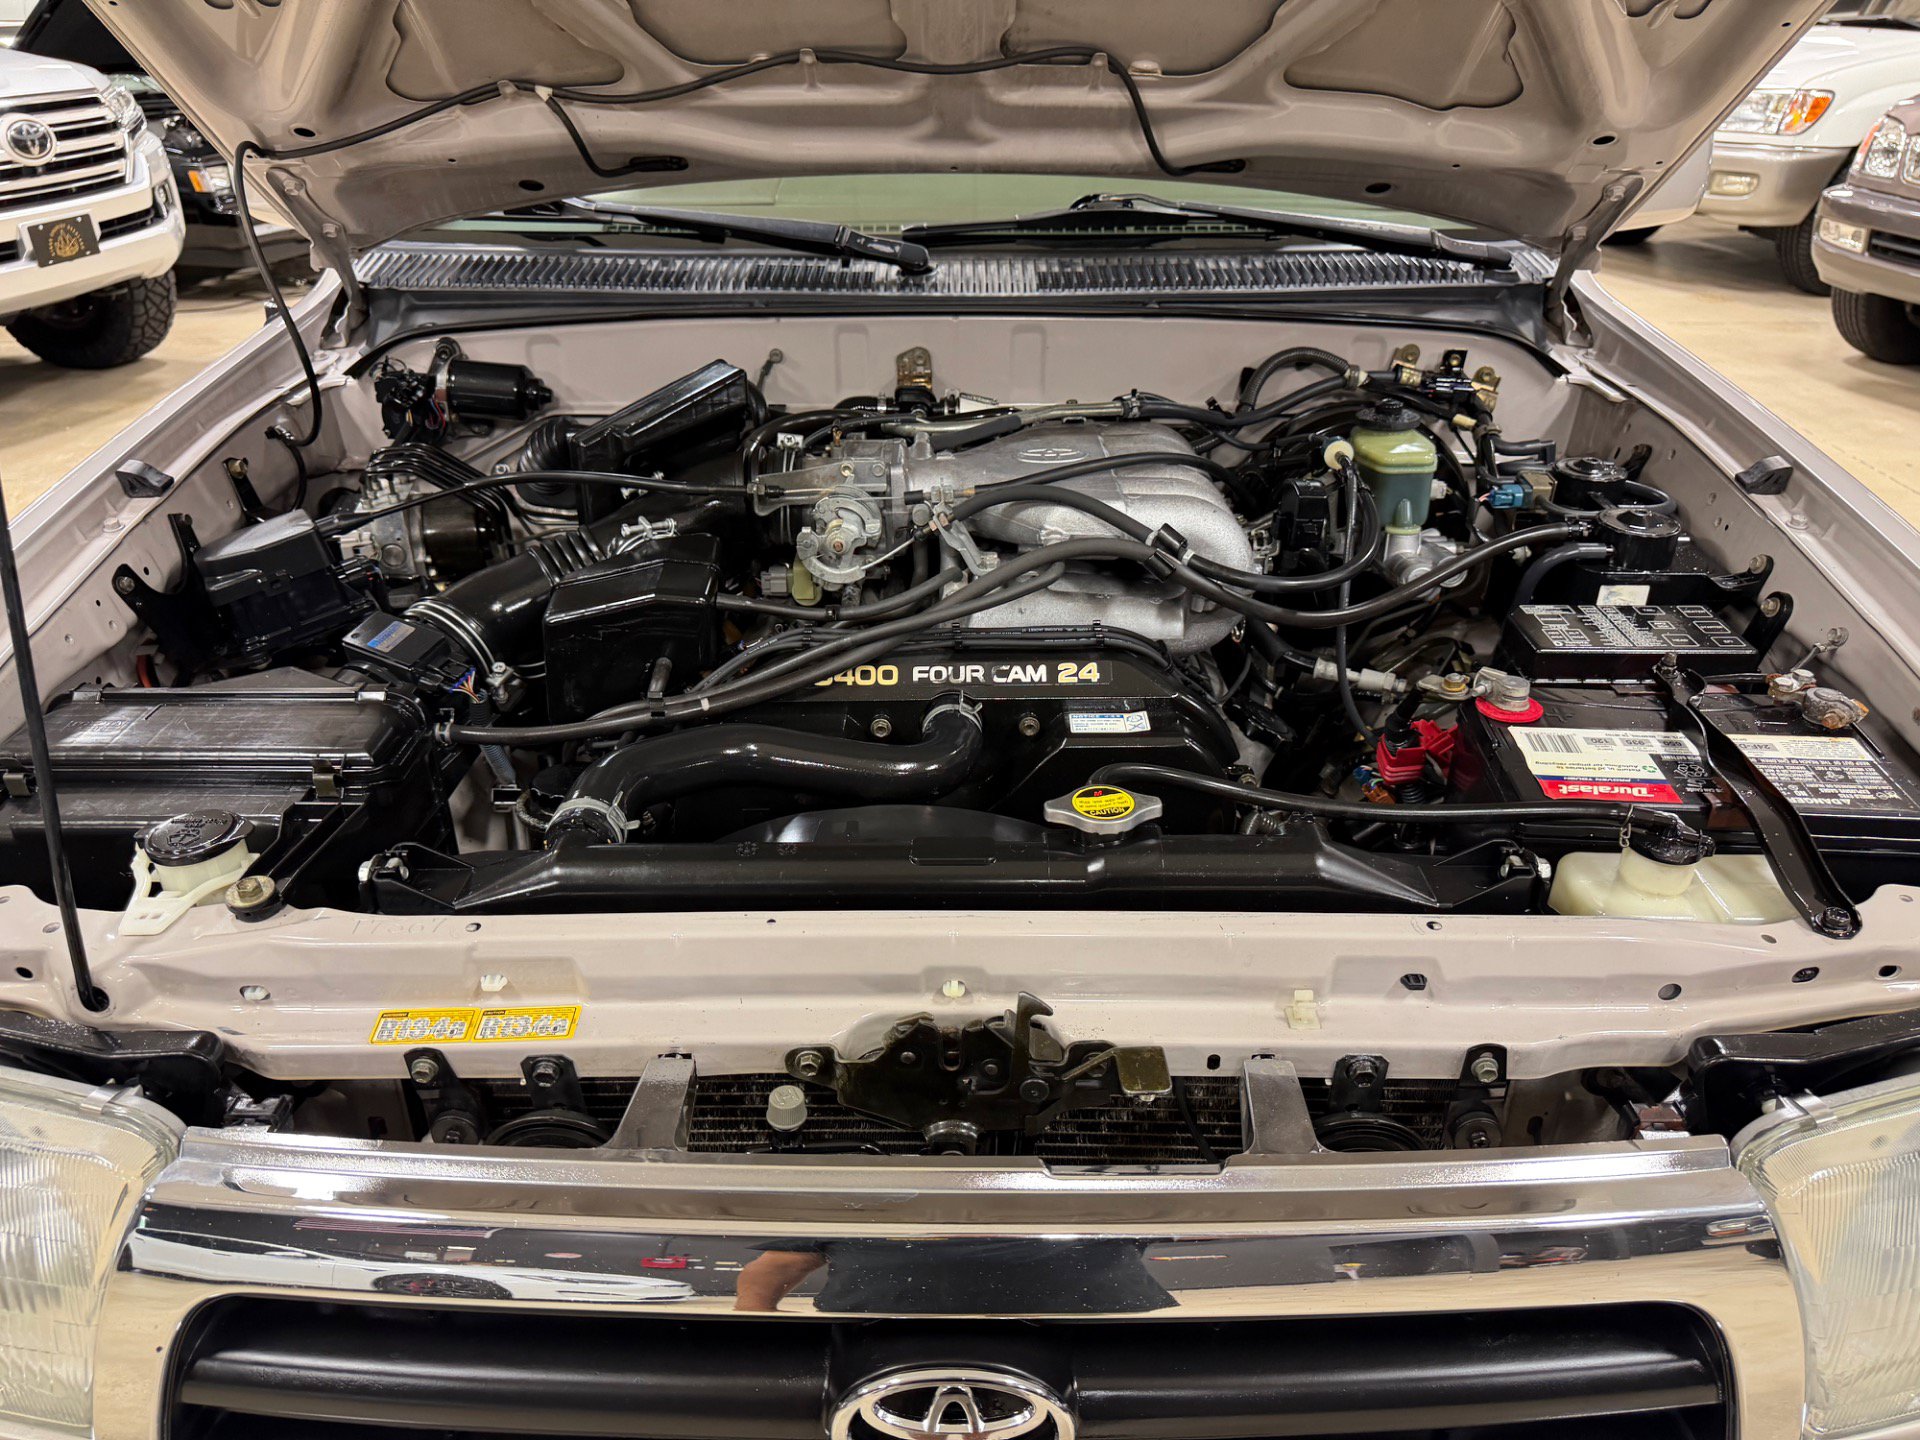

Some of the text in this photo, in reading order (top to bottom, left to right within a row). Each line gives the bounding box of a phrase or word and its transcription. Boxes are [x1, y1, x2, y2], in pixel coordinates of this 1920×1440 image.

[912, 665, 985, 684] FOUR
[992, 664, 1047, 683] CAM
[1057, 662, 1100, 683] 24
[1557, 783, 1655, 798] Duralast
[1089, 806, 1125, 815] CAUTION
